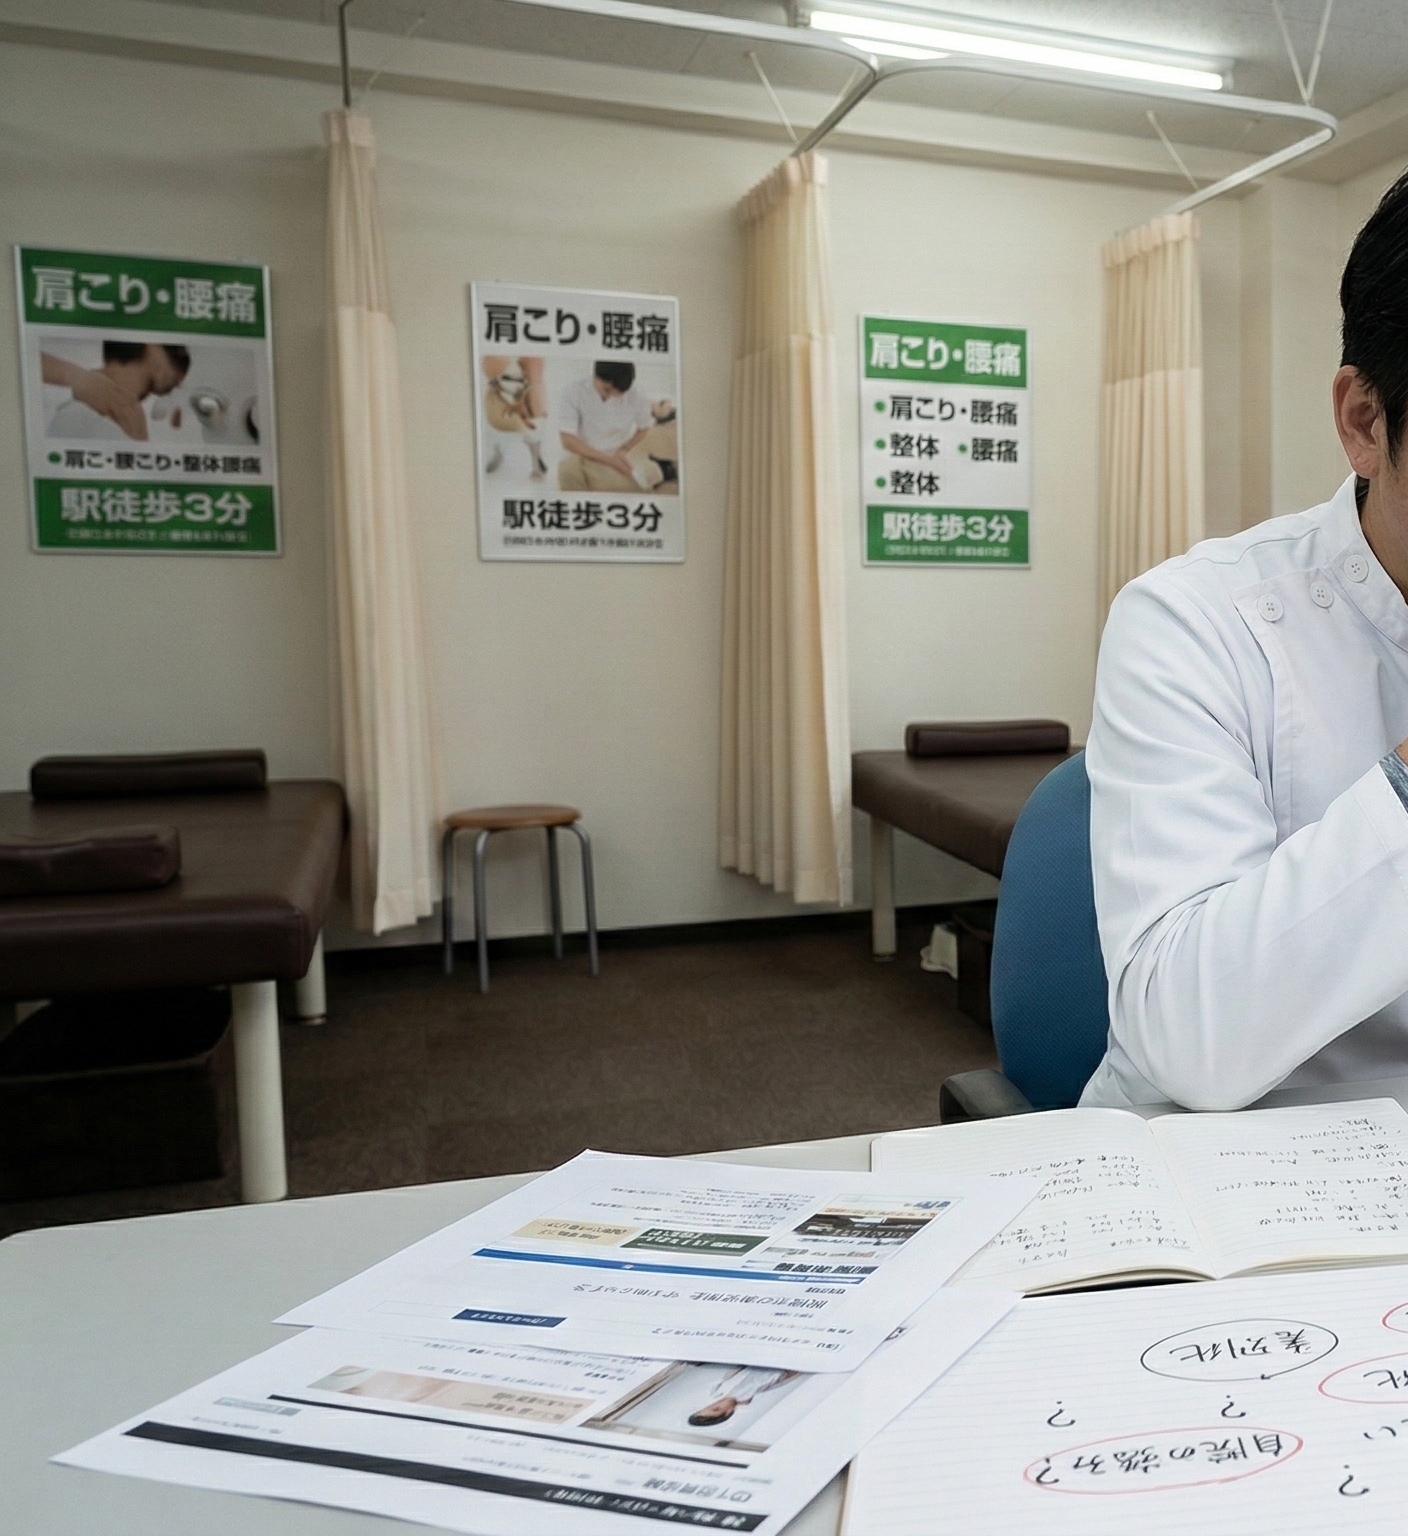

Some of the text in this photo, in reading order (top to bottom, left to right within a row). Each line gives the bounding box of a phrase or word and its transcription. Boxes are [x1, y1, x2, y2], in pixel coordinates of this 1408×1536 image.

[31, 266, 257, 323] 肩こり・腰痛
[484, 304, 670, 352] 肩こり・腰痛
[869, 333, 1021, 377] 肩こり・腰痛
[890, 395, 1018, 427] 肩こり・腰痛
[890, 433, 1018, 463] 整体 腰痛
[890, 471, 940, 496] 整体
[60, 488, 252, 525] 駅徒歩3分
[502, 499, 663, 532] 駅徒歩3分
[882, 512, 1014, 544] 駅徒歩3分
